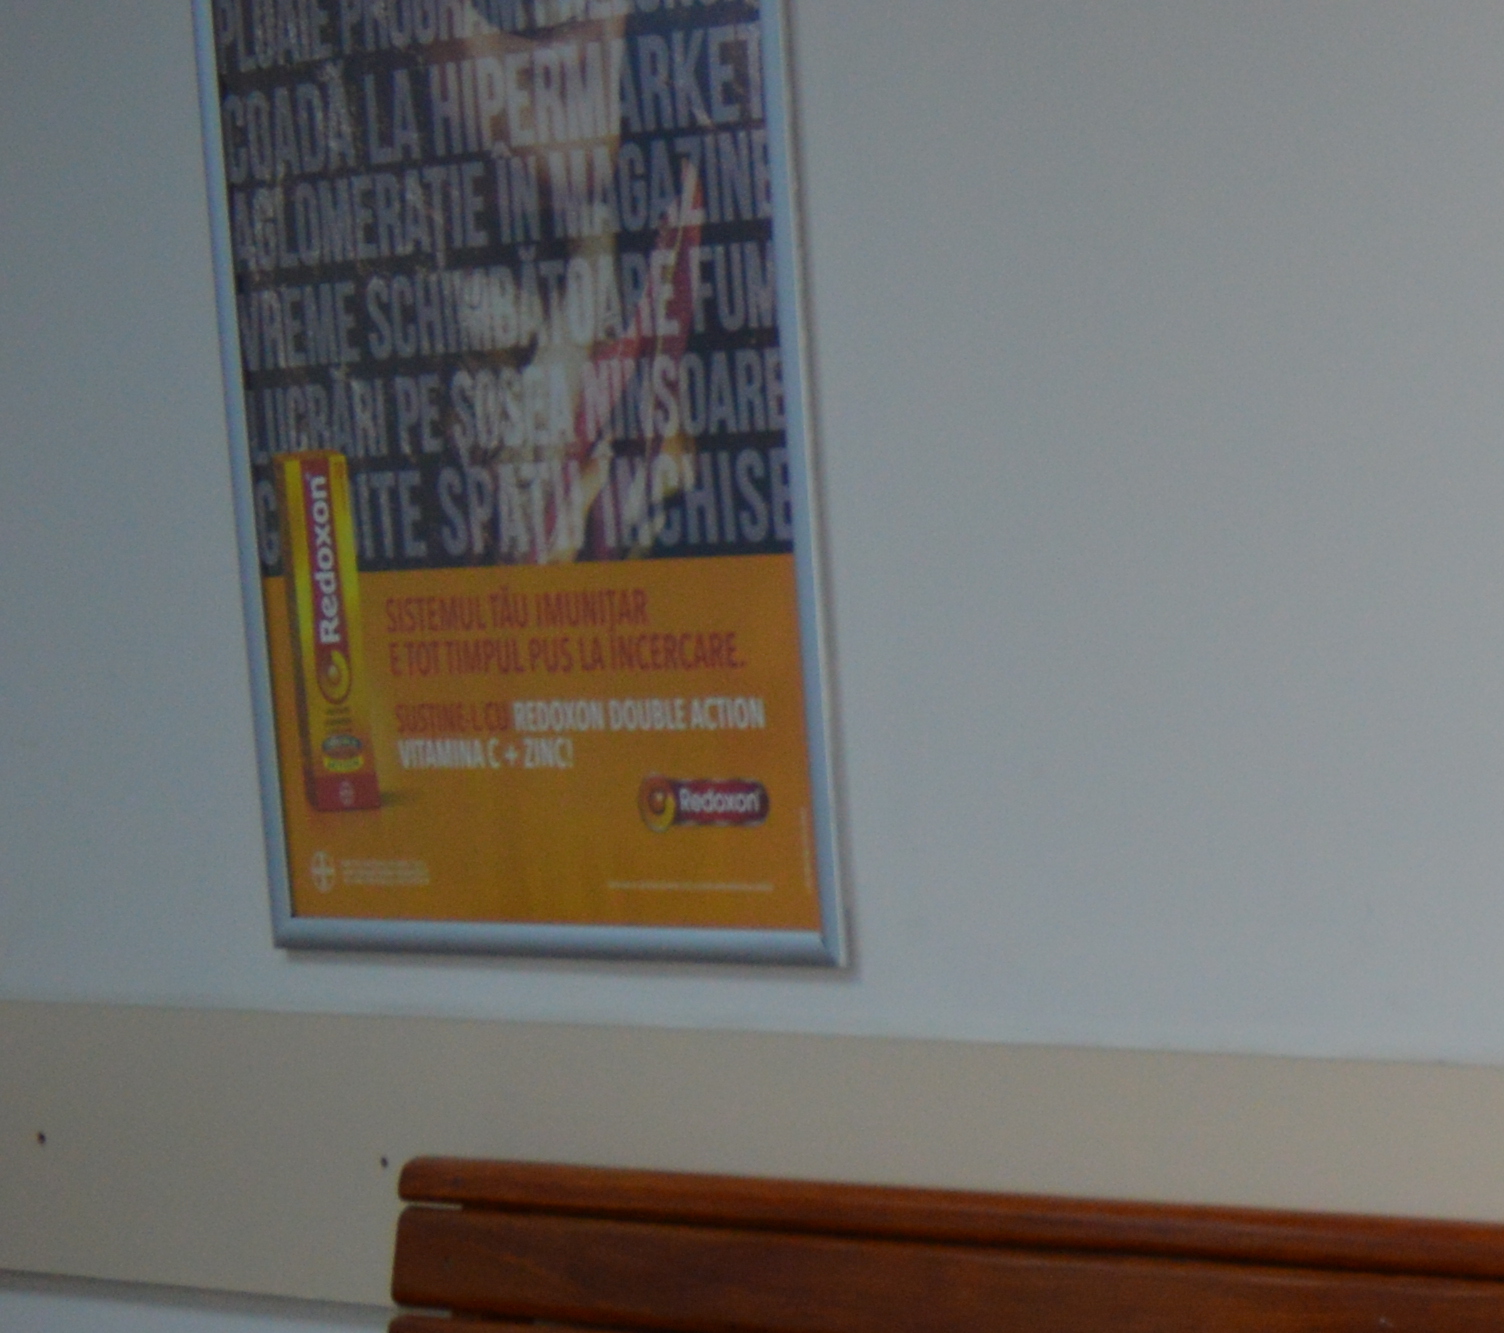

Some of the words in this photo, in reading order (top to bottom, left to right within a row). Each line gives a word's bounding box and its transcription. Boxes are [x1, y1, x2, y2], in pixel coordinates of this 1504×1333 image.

[364, 68, 421, 165] LA
[428, 22, 766, 157] HIPERMARKET
[237, 279, 359, 372] VREME
[396, 373, 444, 453] PE
[310, 475, 342, 645] Redoxon
[386, 595, 486, 633] SISTEMUL
[389, 641, 402, 676] E
[403, 640, 441, 676] TOT
[445, 638, 526, 675] TIMPUL
[528, 636, 573, 673] PUS
[577, 636, 605, 672] LA
[512, 700, 606, 732] REDOXON
[608, 698, 687, 732] DOUBLE
[690, 696, 766, 730] ACTION
[398, 738, 483, 769] VITAMINA
[485, 738, 501, 768] C
[679, 788, 760, 813] Redoxon
